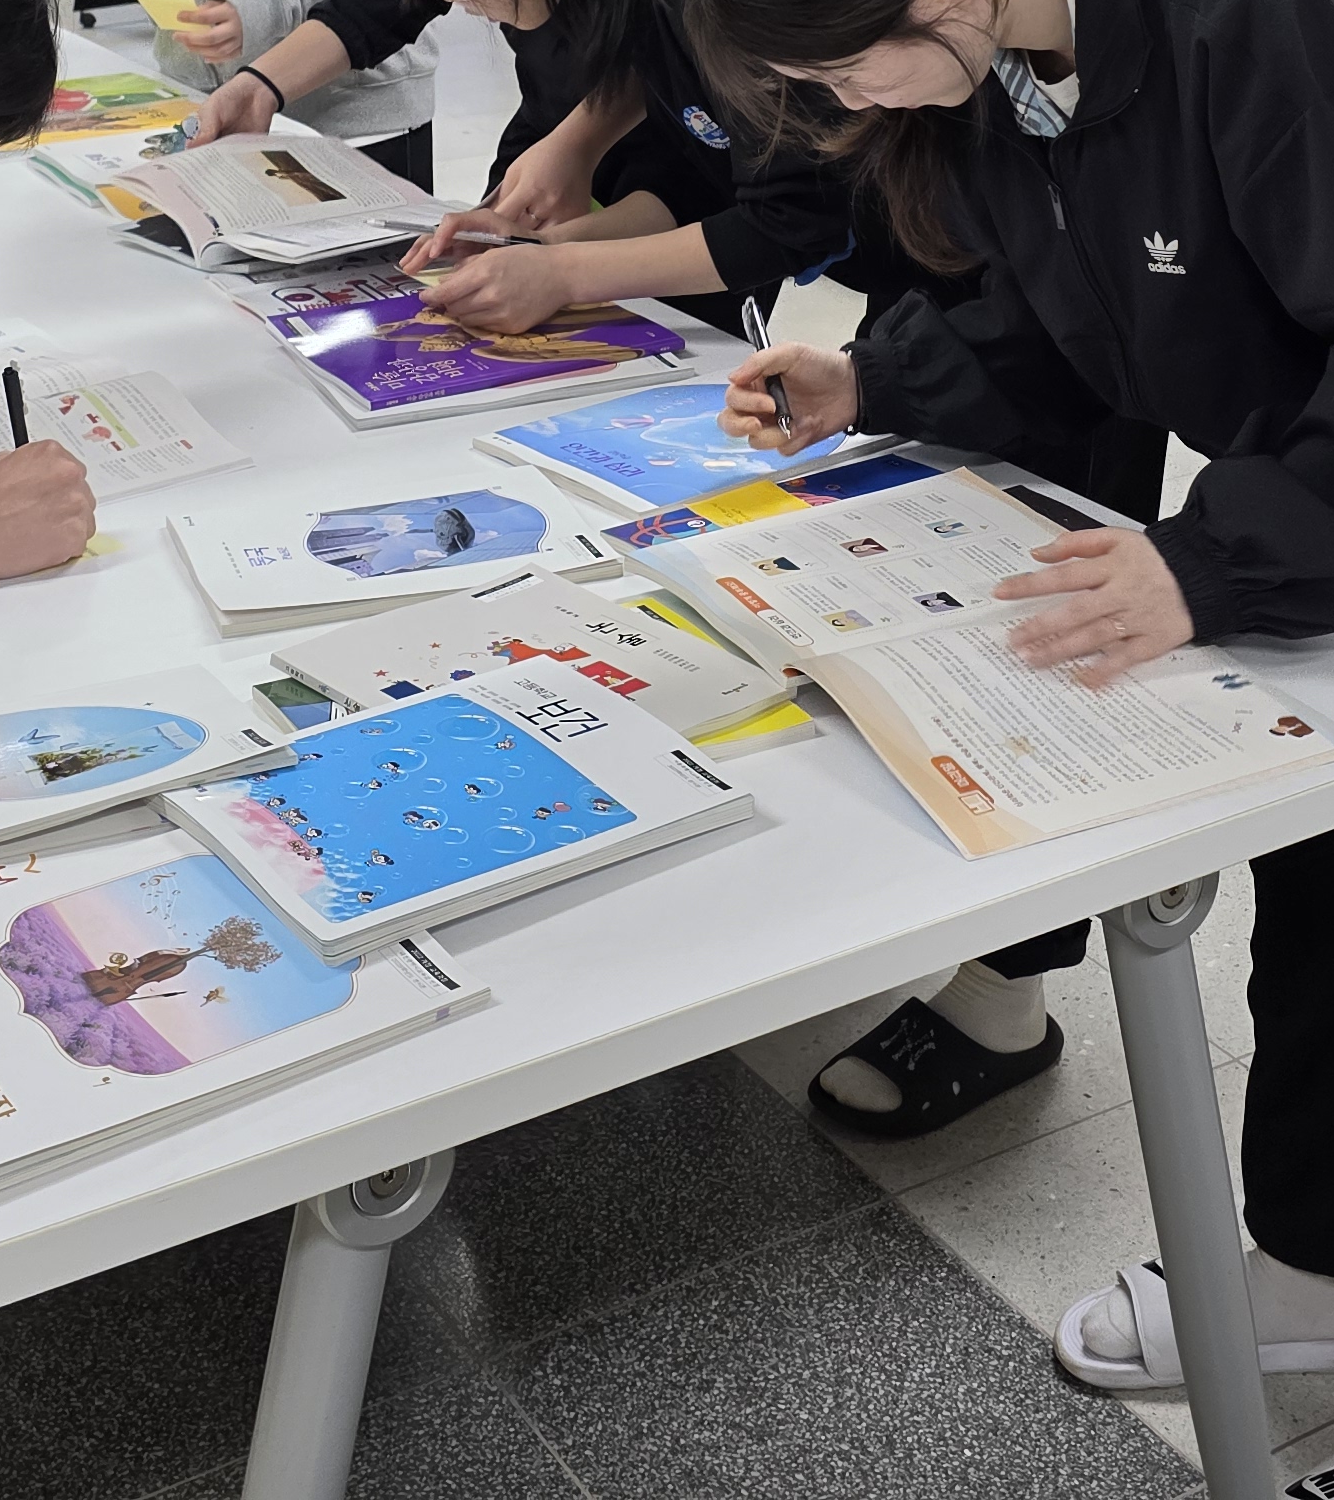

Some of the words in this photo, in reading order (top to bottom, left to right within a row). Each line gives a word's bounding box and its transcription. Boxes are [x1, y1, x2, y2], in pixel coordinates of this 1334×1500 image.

[1147, 261, 1187, 275] adidas
[243, 545, 278, 569] 논술
[514, 698, 609, 743] 보건
